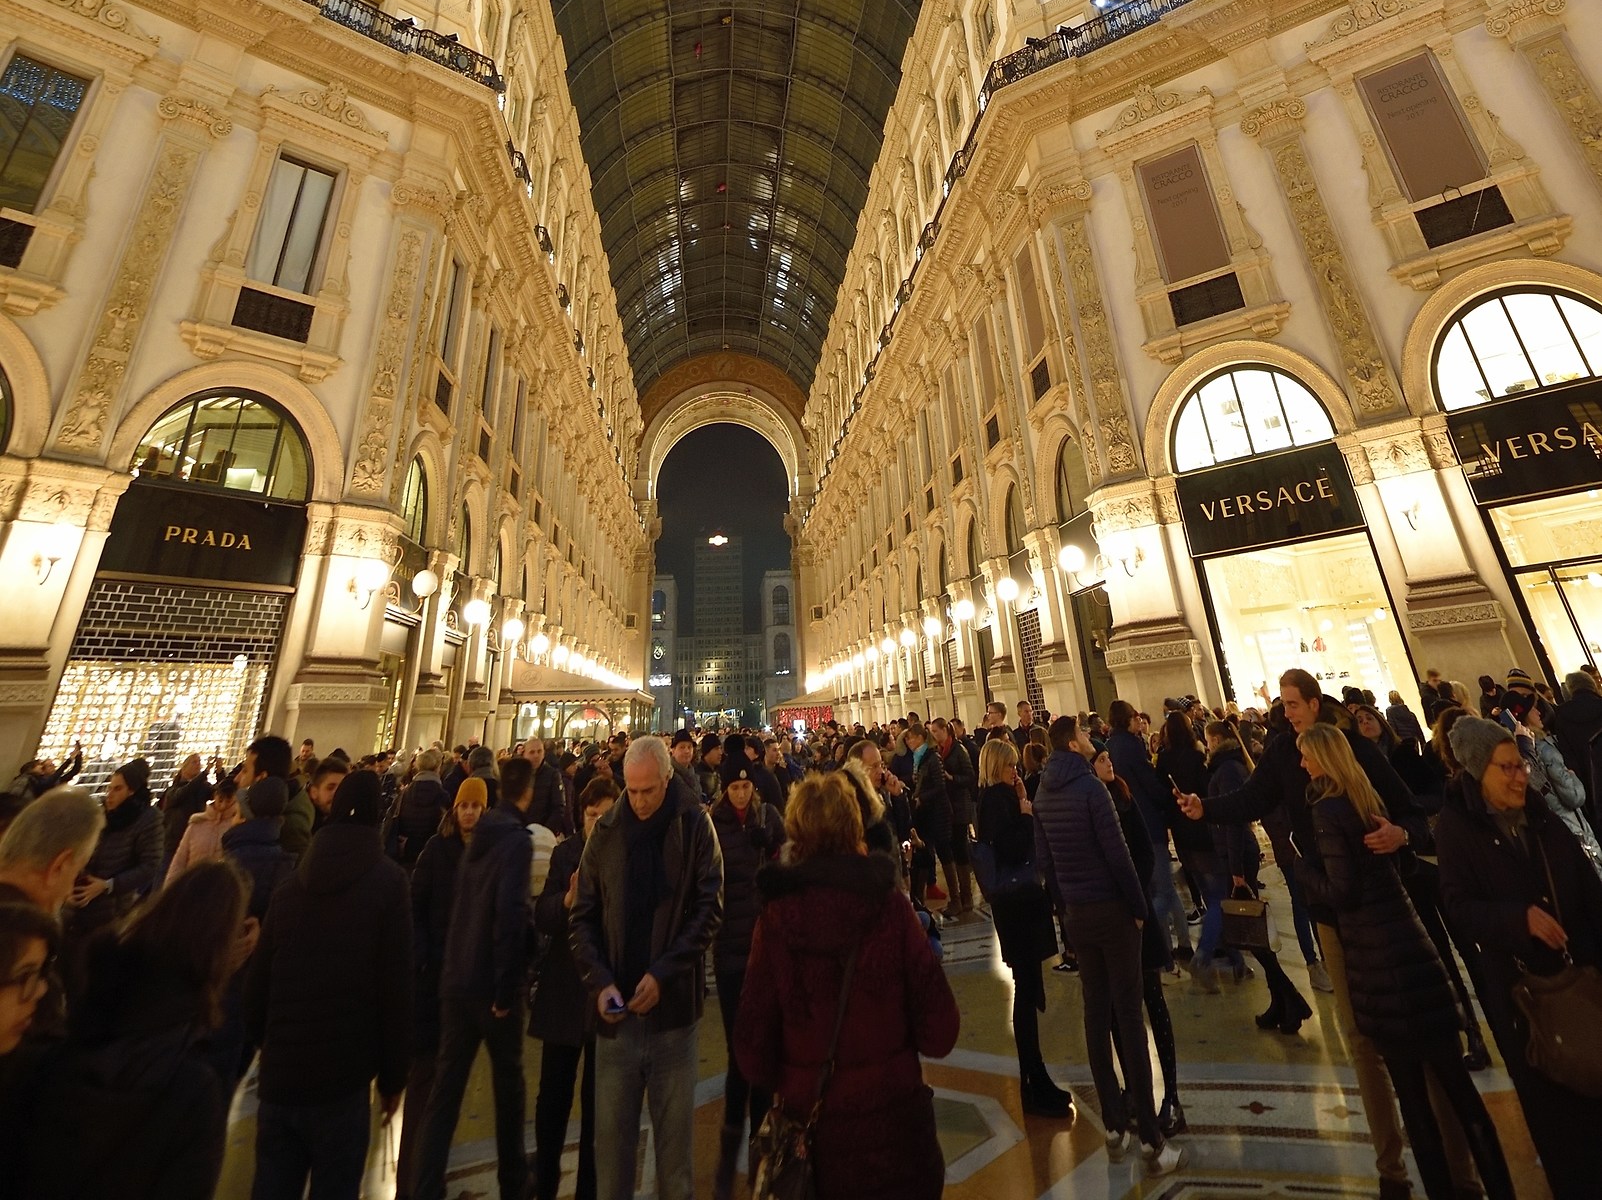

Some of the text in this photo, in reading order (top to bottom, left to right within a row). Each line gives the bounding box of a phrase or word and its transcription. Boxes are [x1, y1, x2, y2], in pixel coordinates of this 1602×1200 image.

[1377, 73, 1424, 94] RISTORANTE
[1381, 79, 1428, 102] CRACCO
[1387, 96, 1437, 119] Next opening
[1406, 109, 1425, 121] 2017
[1154, 169, 1193, 190] CRACCO
[1200, 477, 1334, 521] VERSACE
[164, 525, 252, 550] PRADA
